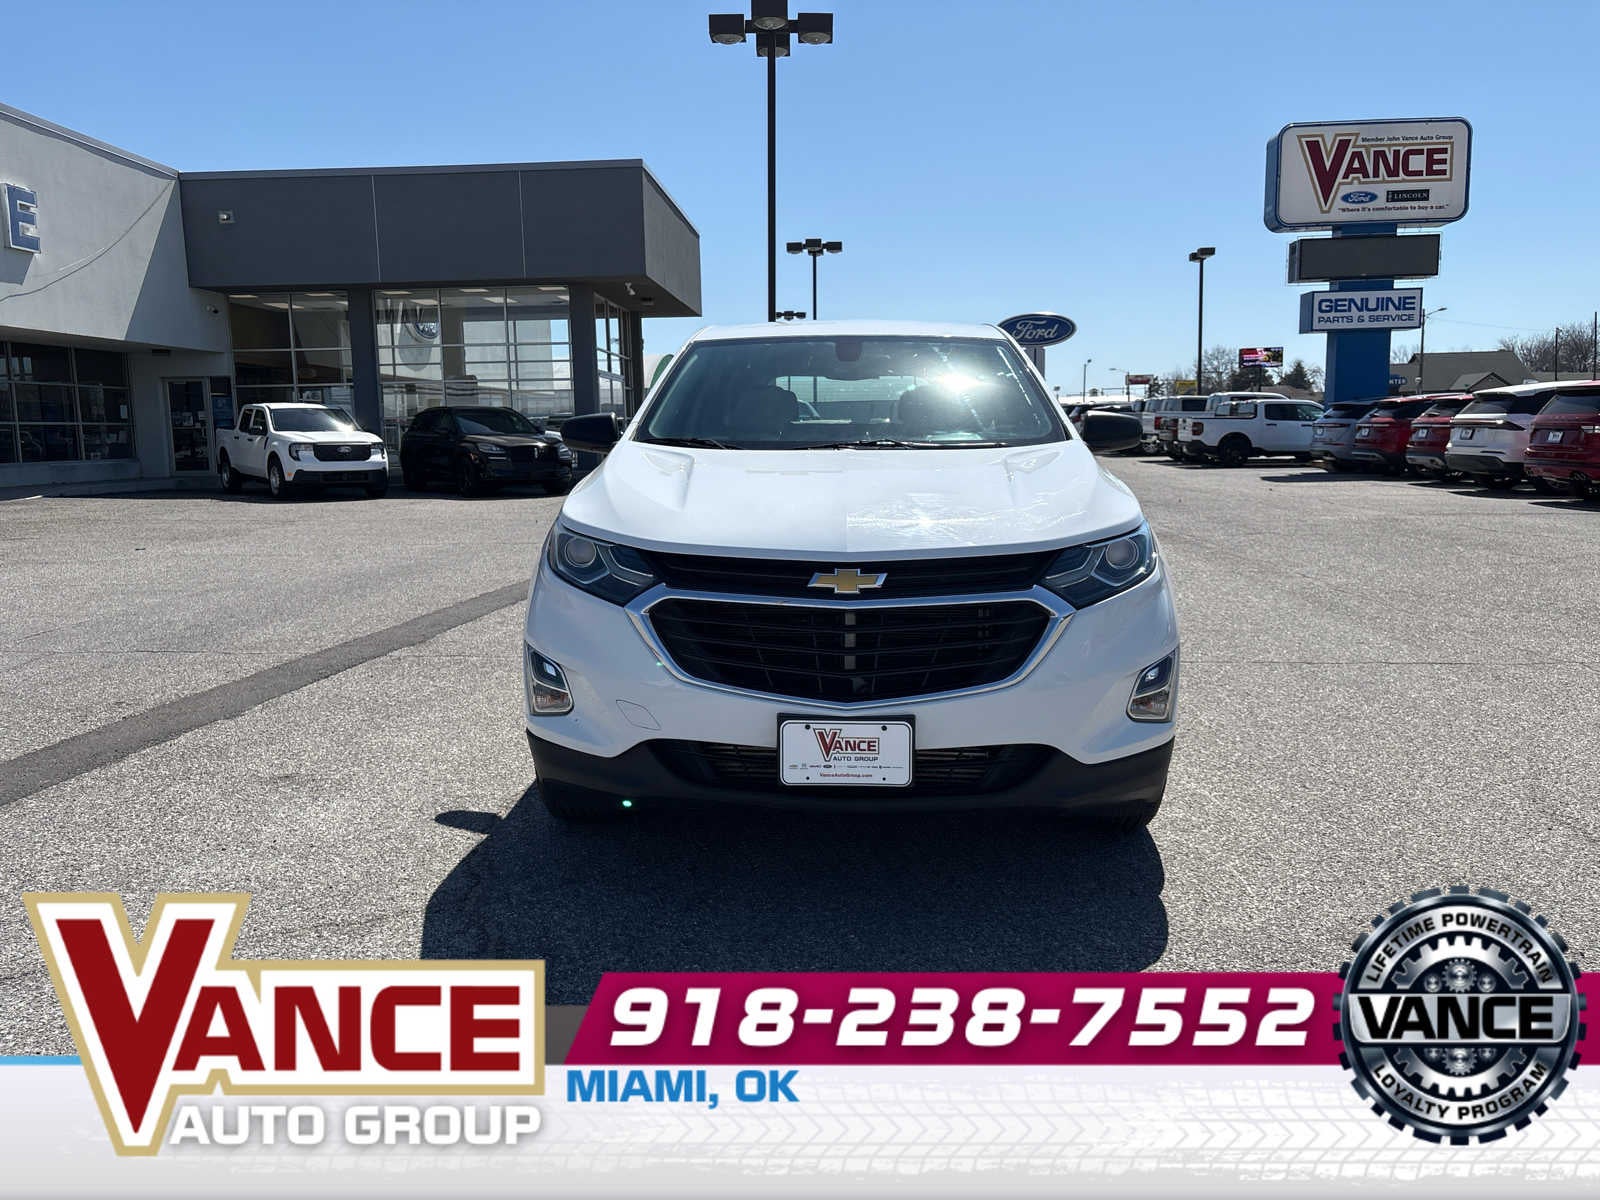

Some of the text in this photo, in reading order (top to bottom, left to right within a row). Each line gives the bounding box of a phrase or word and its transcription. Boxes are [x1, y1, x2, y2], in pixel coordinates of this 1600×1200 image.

[1348, 191, 1371, 203] Ford
[1393, 191, 1429, 200] LINCOLN
[1317, 296, 1416, 314] GENUINE
[1318, 313, 1415, 325] PARTS & SERVICE
[1012, 319, 1059, 340] Ford
[816, 730, 877, 758] VANCE
